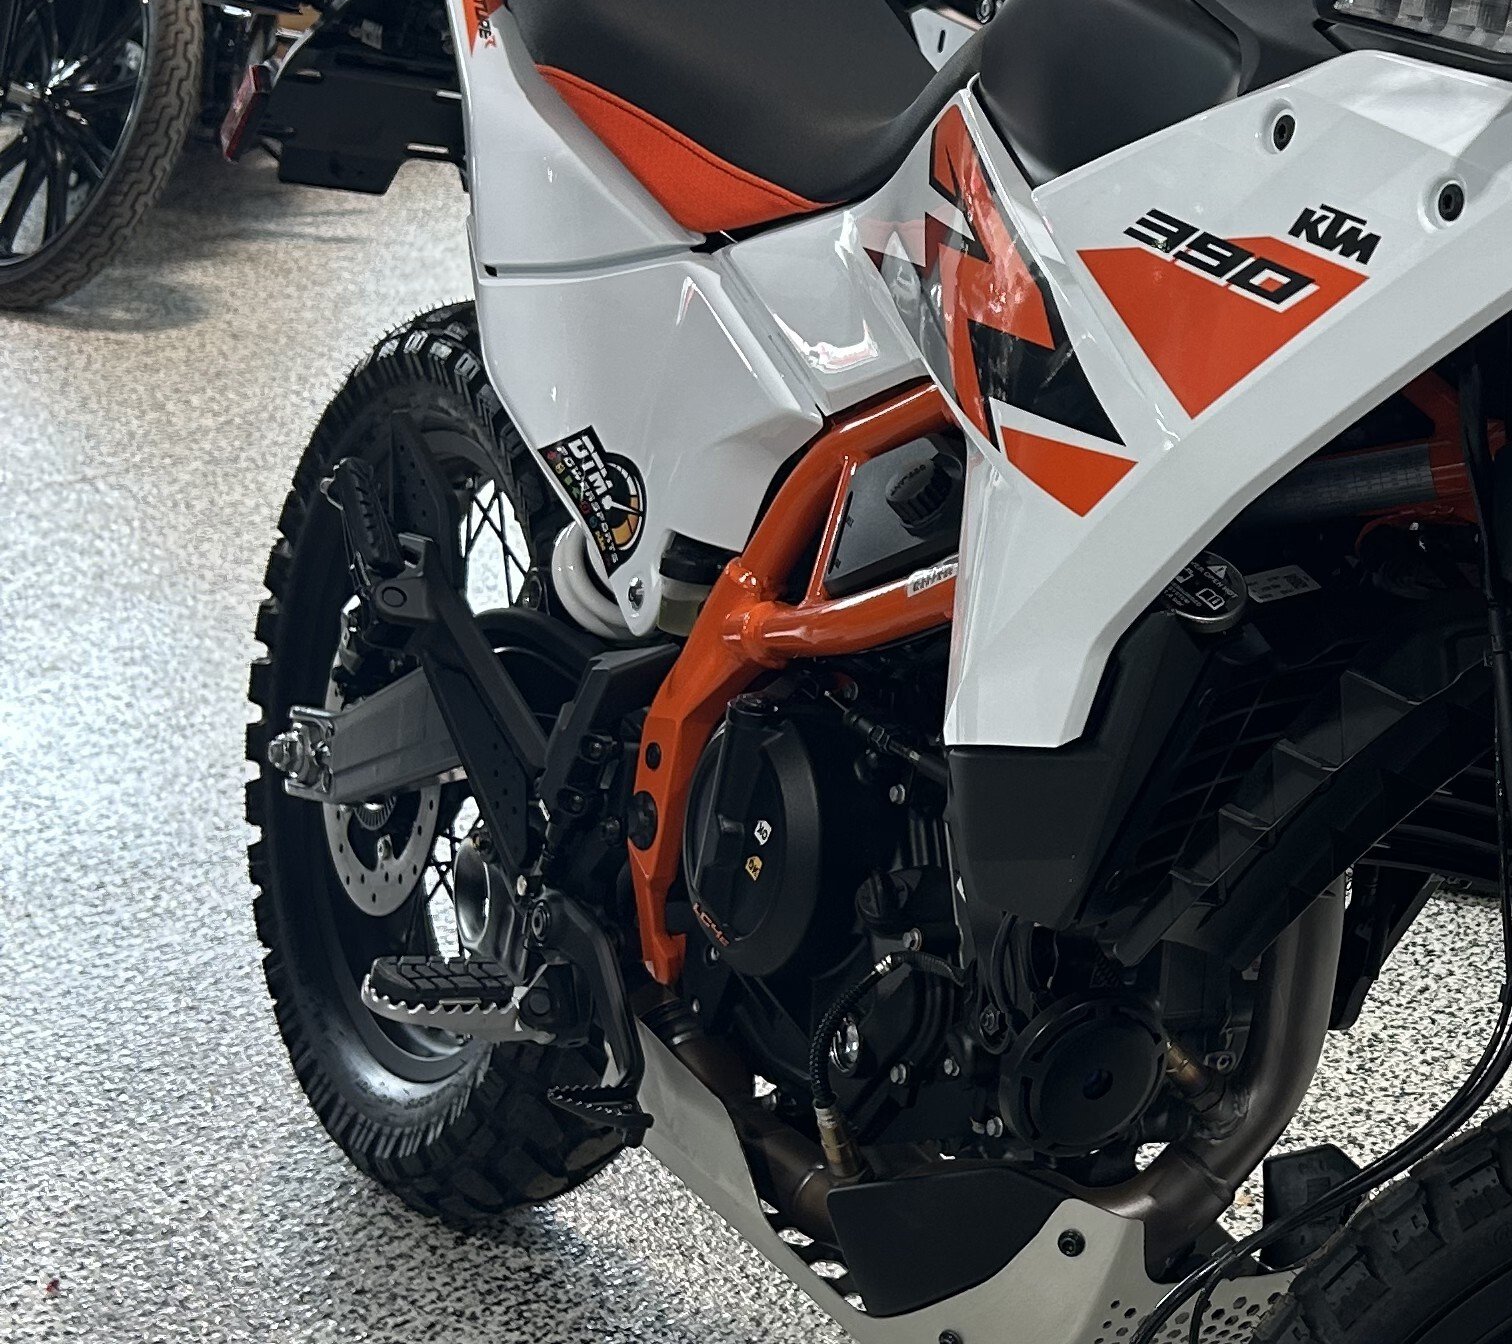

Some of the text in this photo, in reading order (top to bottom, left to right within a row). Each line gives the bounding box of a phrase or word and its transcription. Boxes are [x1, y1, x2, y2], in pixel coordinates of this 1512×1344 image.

[1123, 208, 1317, 305] 390
[1288, 203, 1382, 265] KTM
[567, 434, 614, 496] DTM
